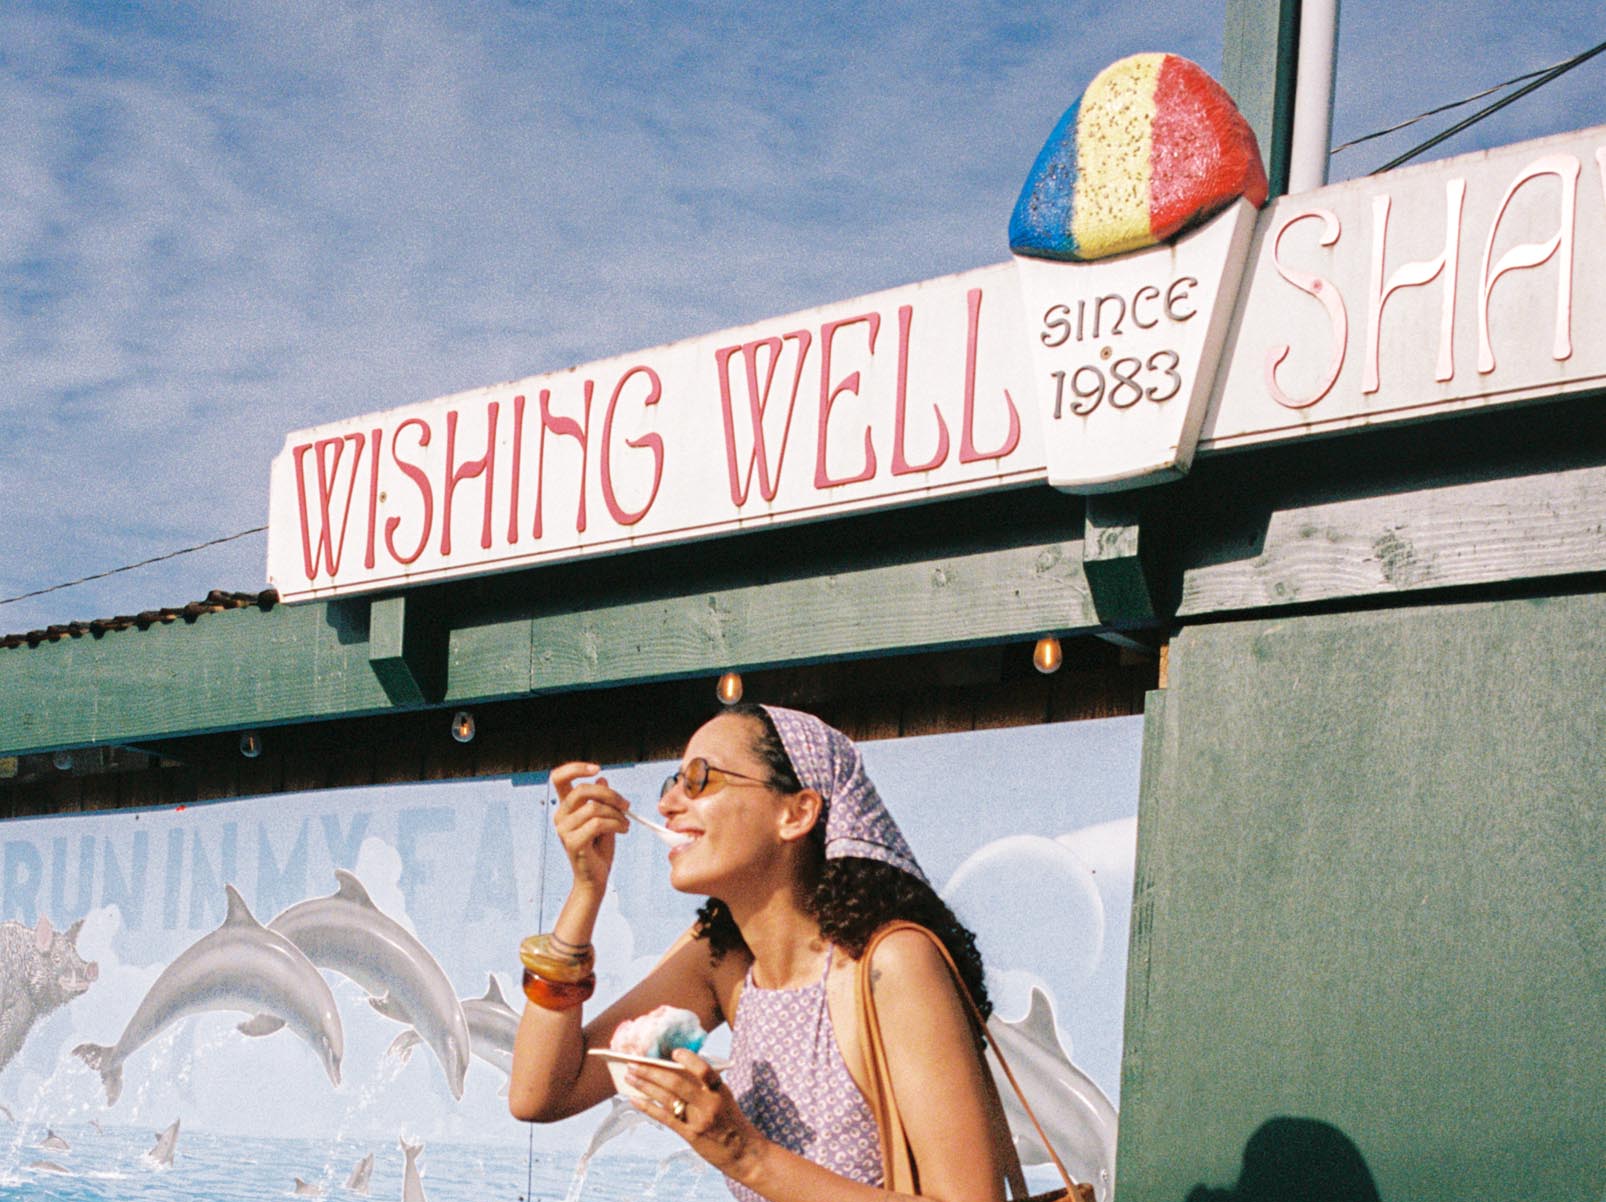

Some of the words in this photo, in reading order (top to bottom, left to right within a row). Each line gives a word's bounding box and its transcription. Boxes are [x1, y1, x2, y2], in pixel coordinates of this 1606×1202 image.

[291, 365, 665, 581] WISHING
[714, 287, 1021, 508] WELL
[1264, 146, 1606, 410] SHA
[1050, 349, 1183, 421] 1983
